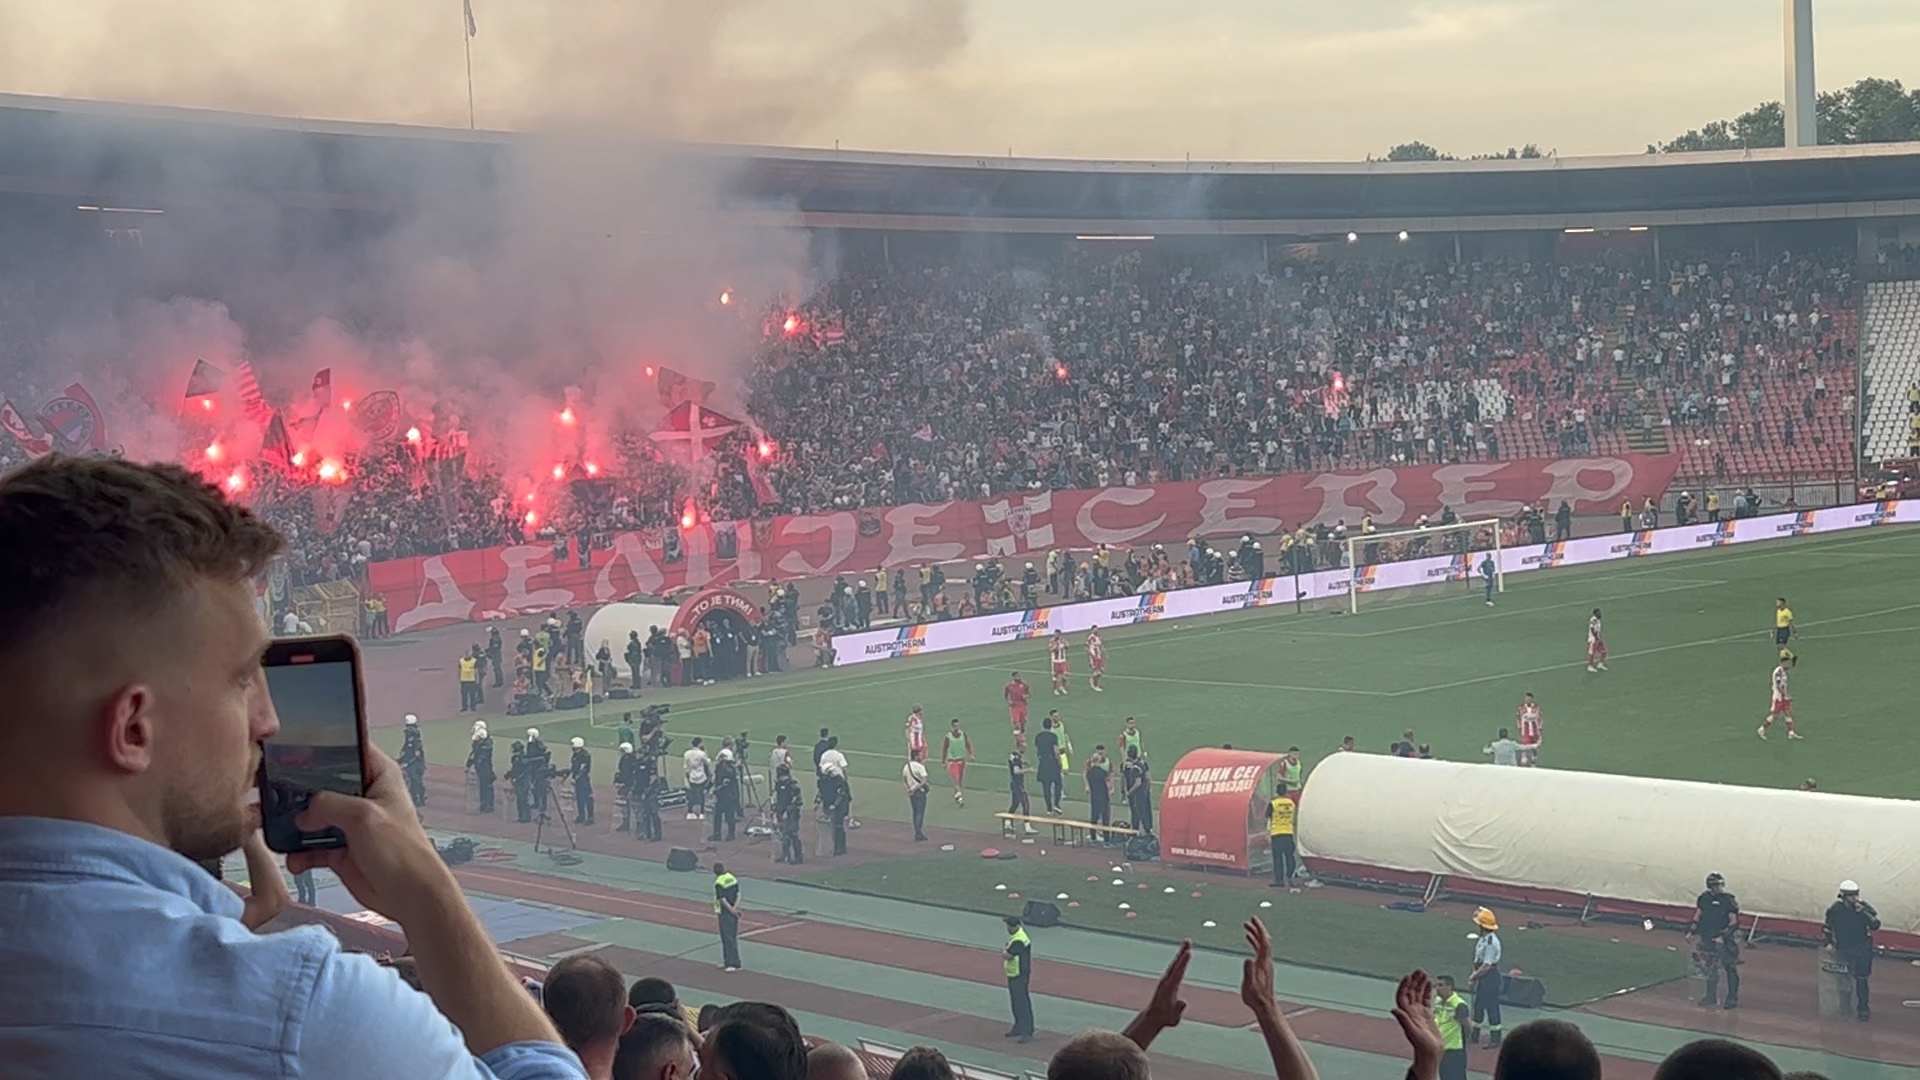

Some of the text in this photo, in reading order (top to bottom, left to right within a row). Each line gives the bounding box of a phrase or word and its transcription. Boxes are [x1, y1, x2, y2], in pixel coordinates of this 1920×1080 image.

[1075, 457, 1634, 544] СЕВЕР
[710, 595, 722, 607] ЈЕ
[723, 595, 754, 616] ТИМ!
[1222, 590, 1273, 605] AUSTROTHERM
[1110, 604, 1165, 620] AUSTROTHERM
[991, 621, 1049, 637] AUSTROTHERM
[865, 637, 927, 655] AUSTROTHERM
[1172, 765, 1261, 785] УЧЛАНИ СЕ!
